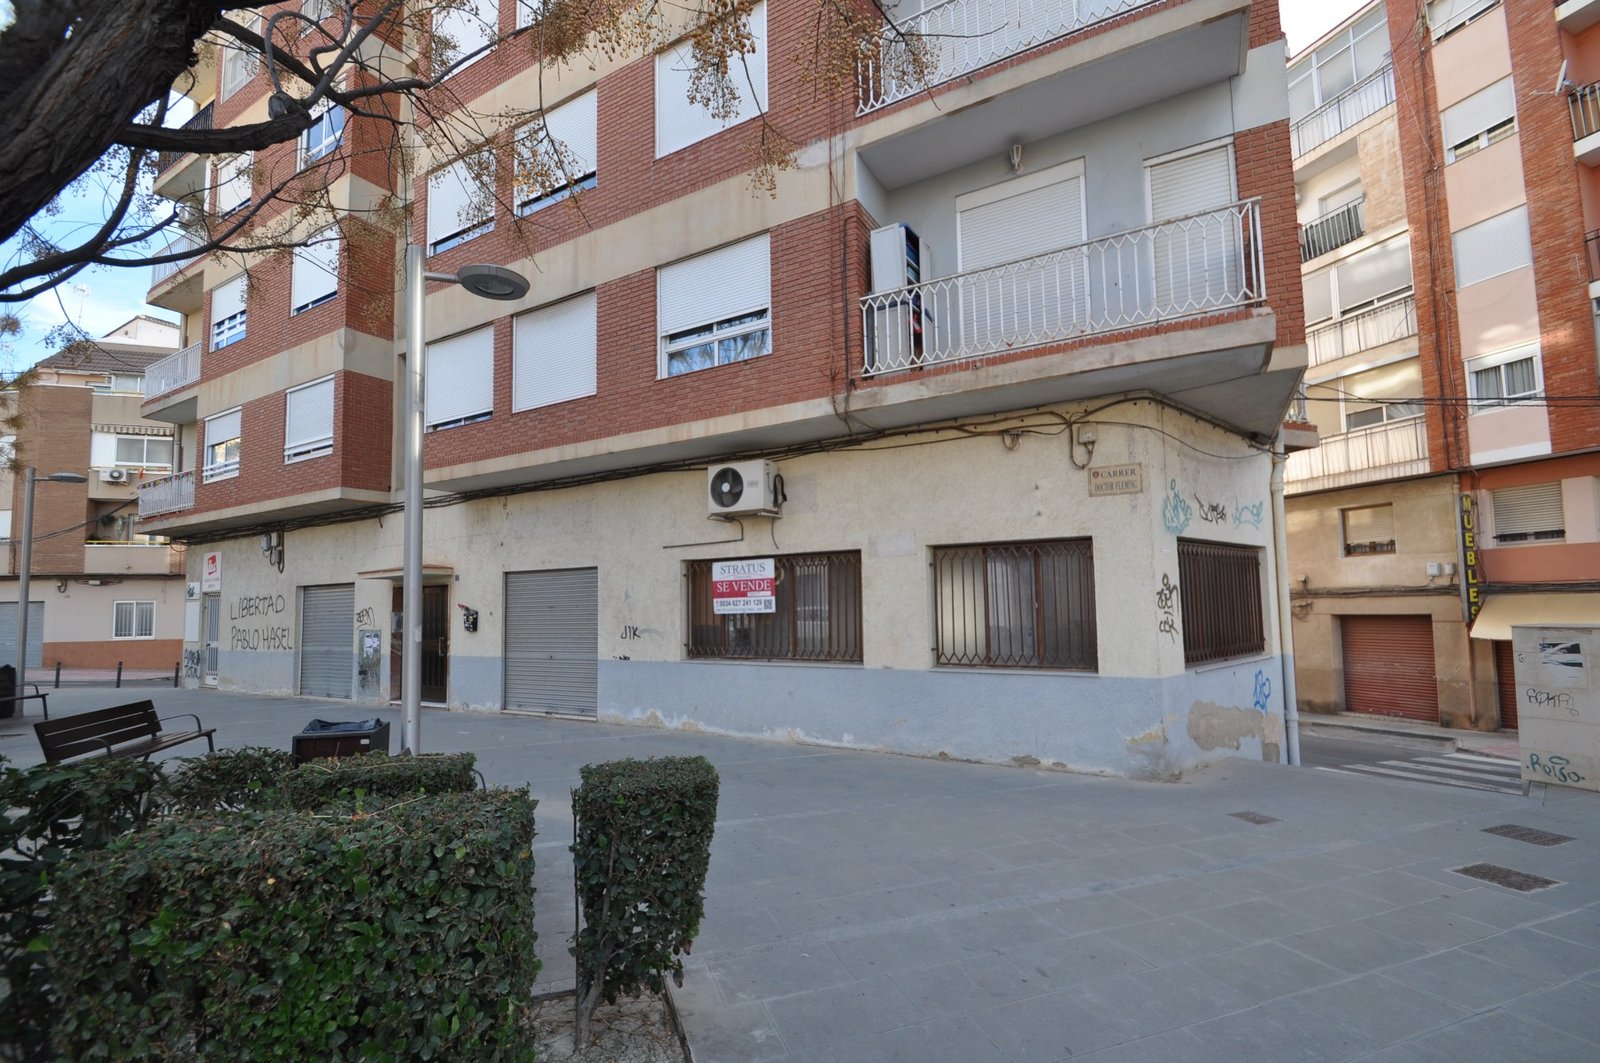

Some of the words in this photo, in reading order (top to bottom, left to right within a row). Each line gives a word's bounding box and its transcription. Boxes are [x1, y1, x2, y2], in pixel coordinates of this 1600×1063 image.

[1100, 468, 1137, 479] CARRER
[720, 563, 766, 575] STRATUS
[716, 582, 730, 593] SE
[732, 580, 771, 592] VENDE
[231, 594, 286, 620] LIBERTAD
[231, 625, 260, 651] PABLO
[262, 625, 293, 650] HASEL
